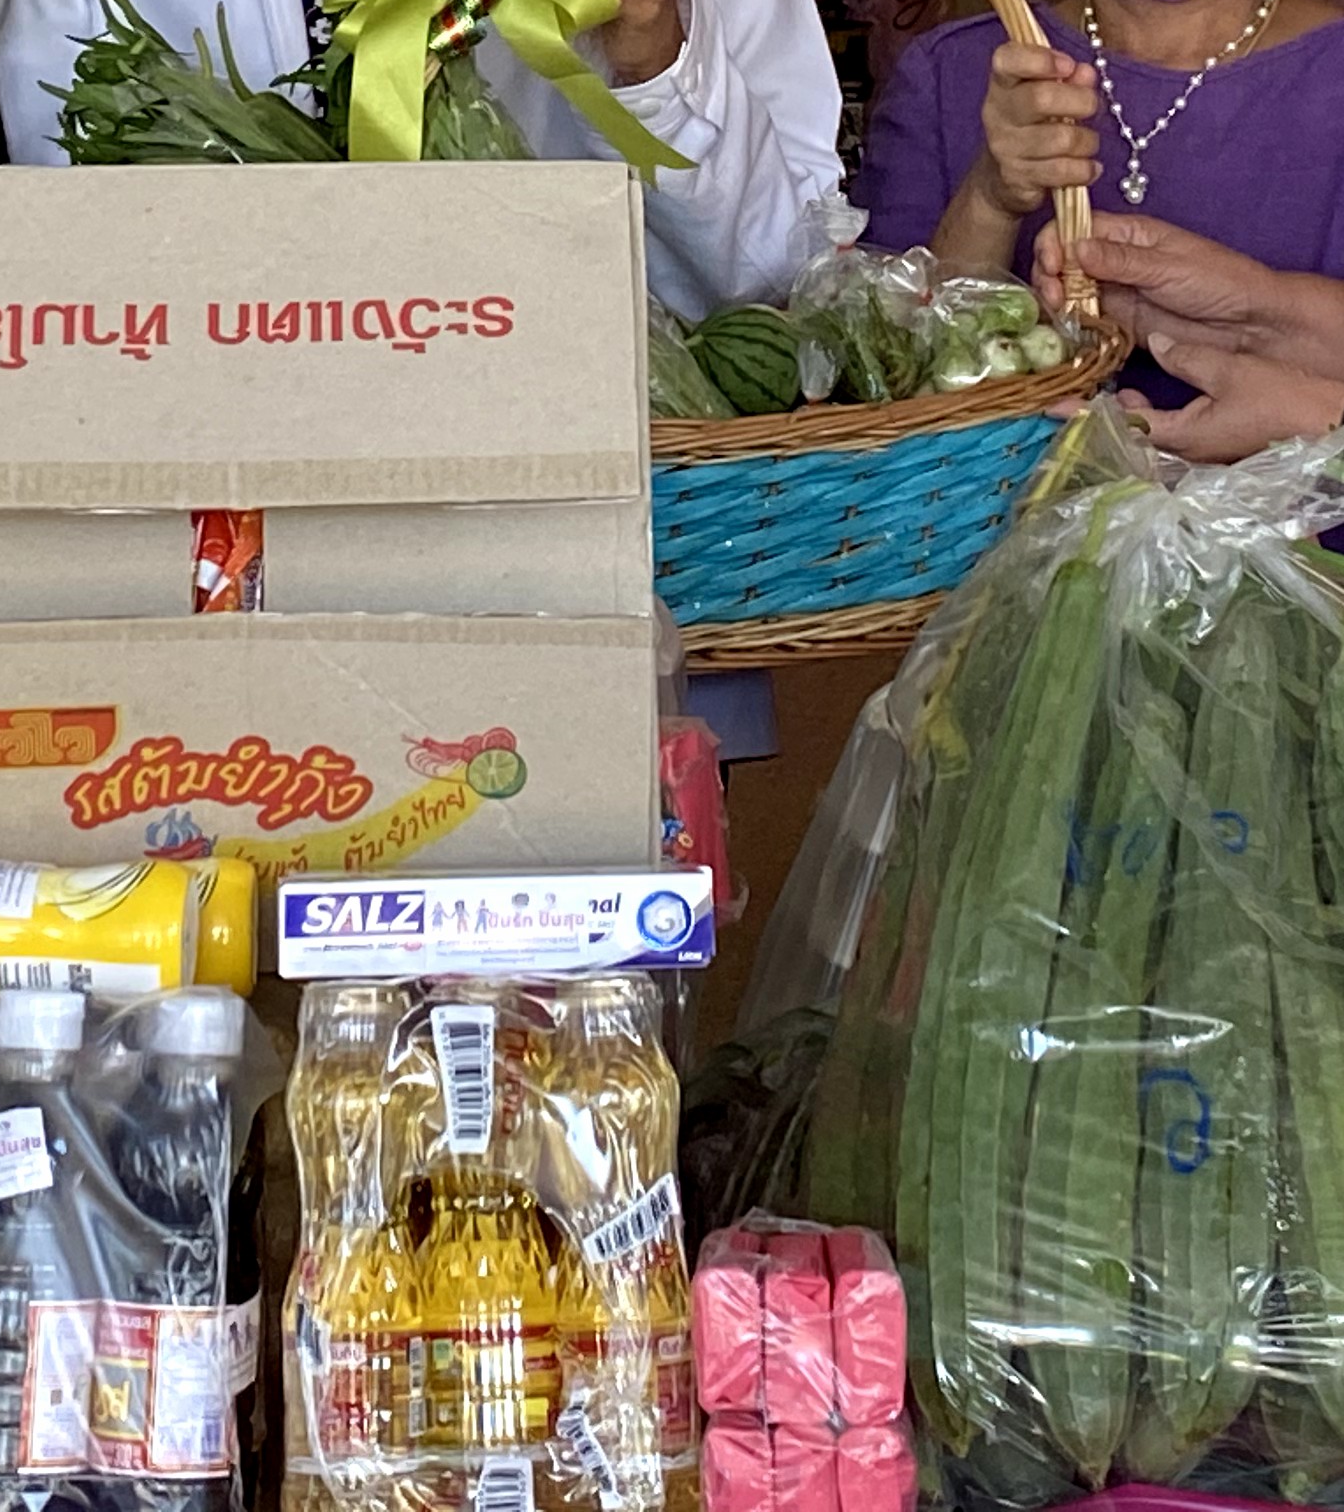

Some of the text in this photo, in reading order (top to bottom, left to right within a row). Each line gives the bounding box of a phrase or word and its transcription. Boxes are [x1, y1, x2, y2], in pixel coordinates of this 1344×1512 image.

[207, 296, 515, 353] ระวังแตก
[73, 743, 366, 824] รสต้มยำกุ้ง
[343, 784, 467, 872] ต้มยำไทย
[301, 894, 425, 935] SALZ
